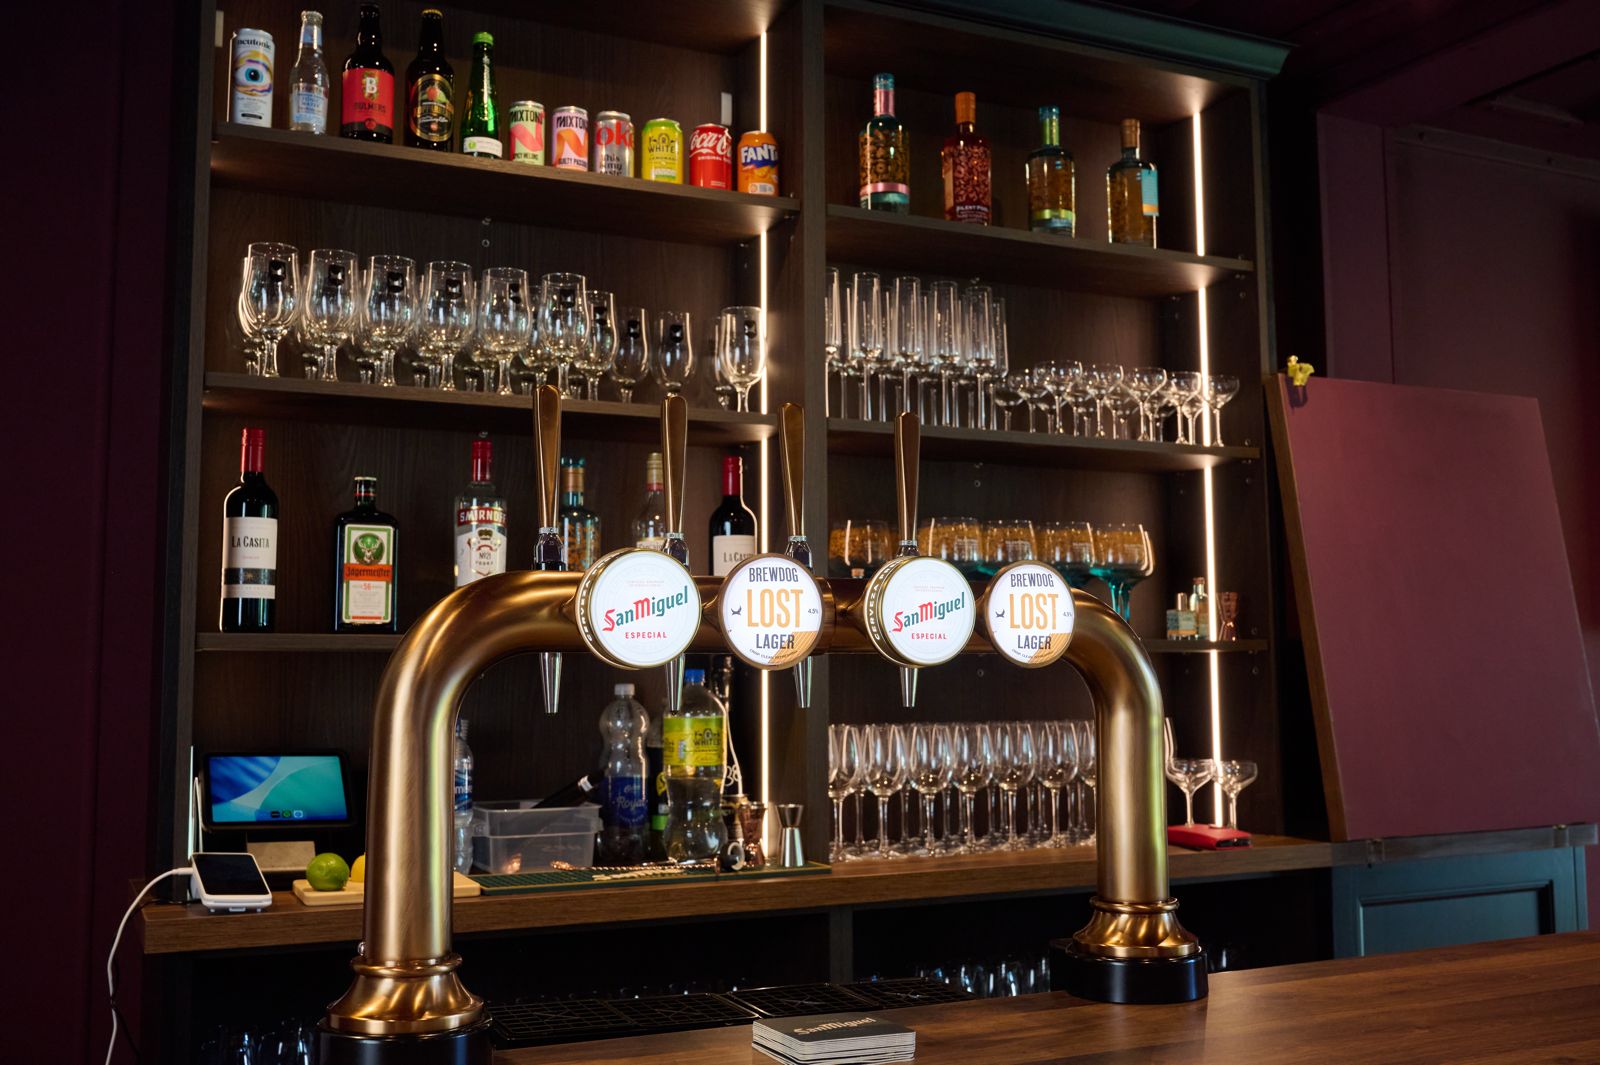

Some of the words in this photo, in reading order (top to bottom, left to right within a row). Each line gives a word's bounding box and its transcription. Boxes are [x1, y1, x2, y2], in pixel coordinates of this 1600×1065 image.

[365, 77, 377, 94] B
[354, 102, 386, 113] BULMERS
[459, 509, 506, 522] SMIRNOFF
[232, 536, 241, 548] LA
[243, 535, 270, 549] CASITA
[748, 566, 799, 583] BREWDOG
[1010, 572, 1055, 588] BREWDOG
[746, 588, 804, 628] LOST
[1008, 592, 1059, 631] LOST
[625, 631, 668, 639] ESPECIAL
[755, 633, 795, 650] LAGER
[911, 632, 948, 640] ESPECIAL
[1017, 634, 1052, 650] LAGER
